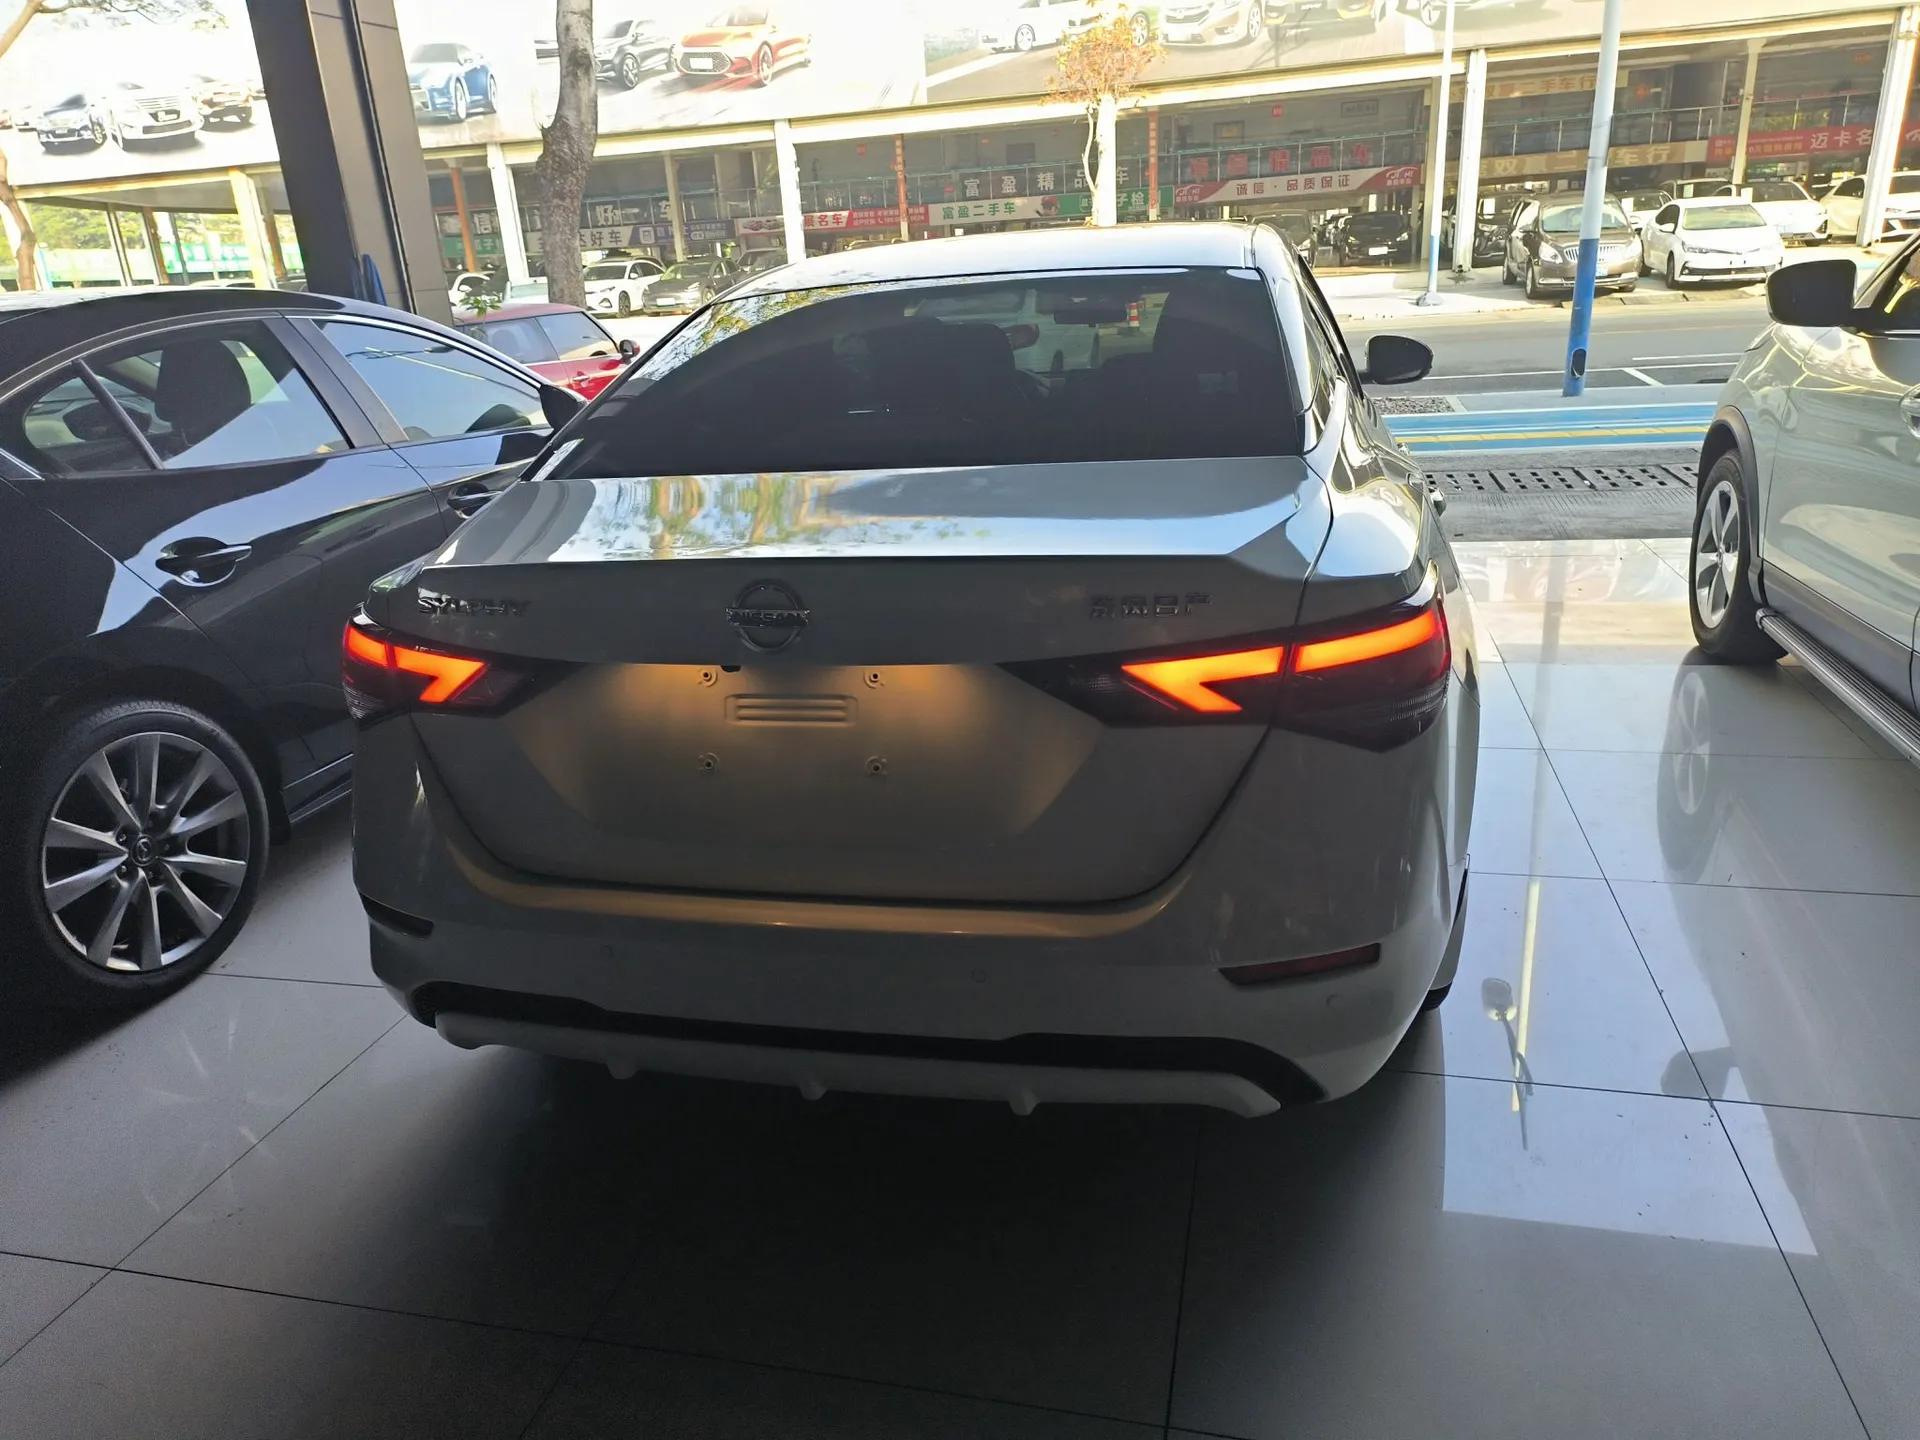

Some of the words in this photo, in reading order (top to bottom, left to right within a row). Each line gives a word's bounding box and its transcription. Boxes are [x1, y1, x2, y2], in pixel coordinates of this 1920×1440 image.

[942, 201, 1016, 220] 富盈二手车
